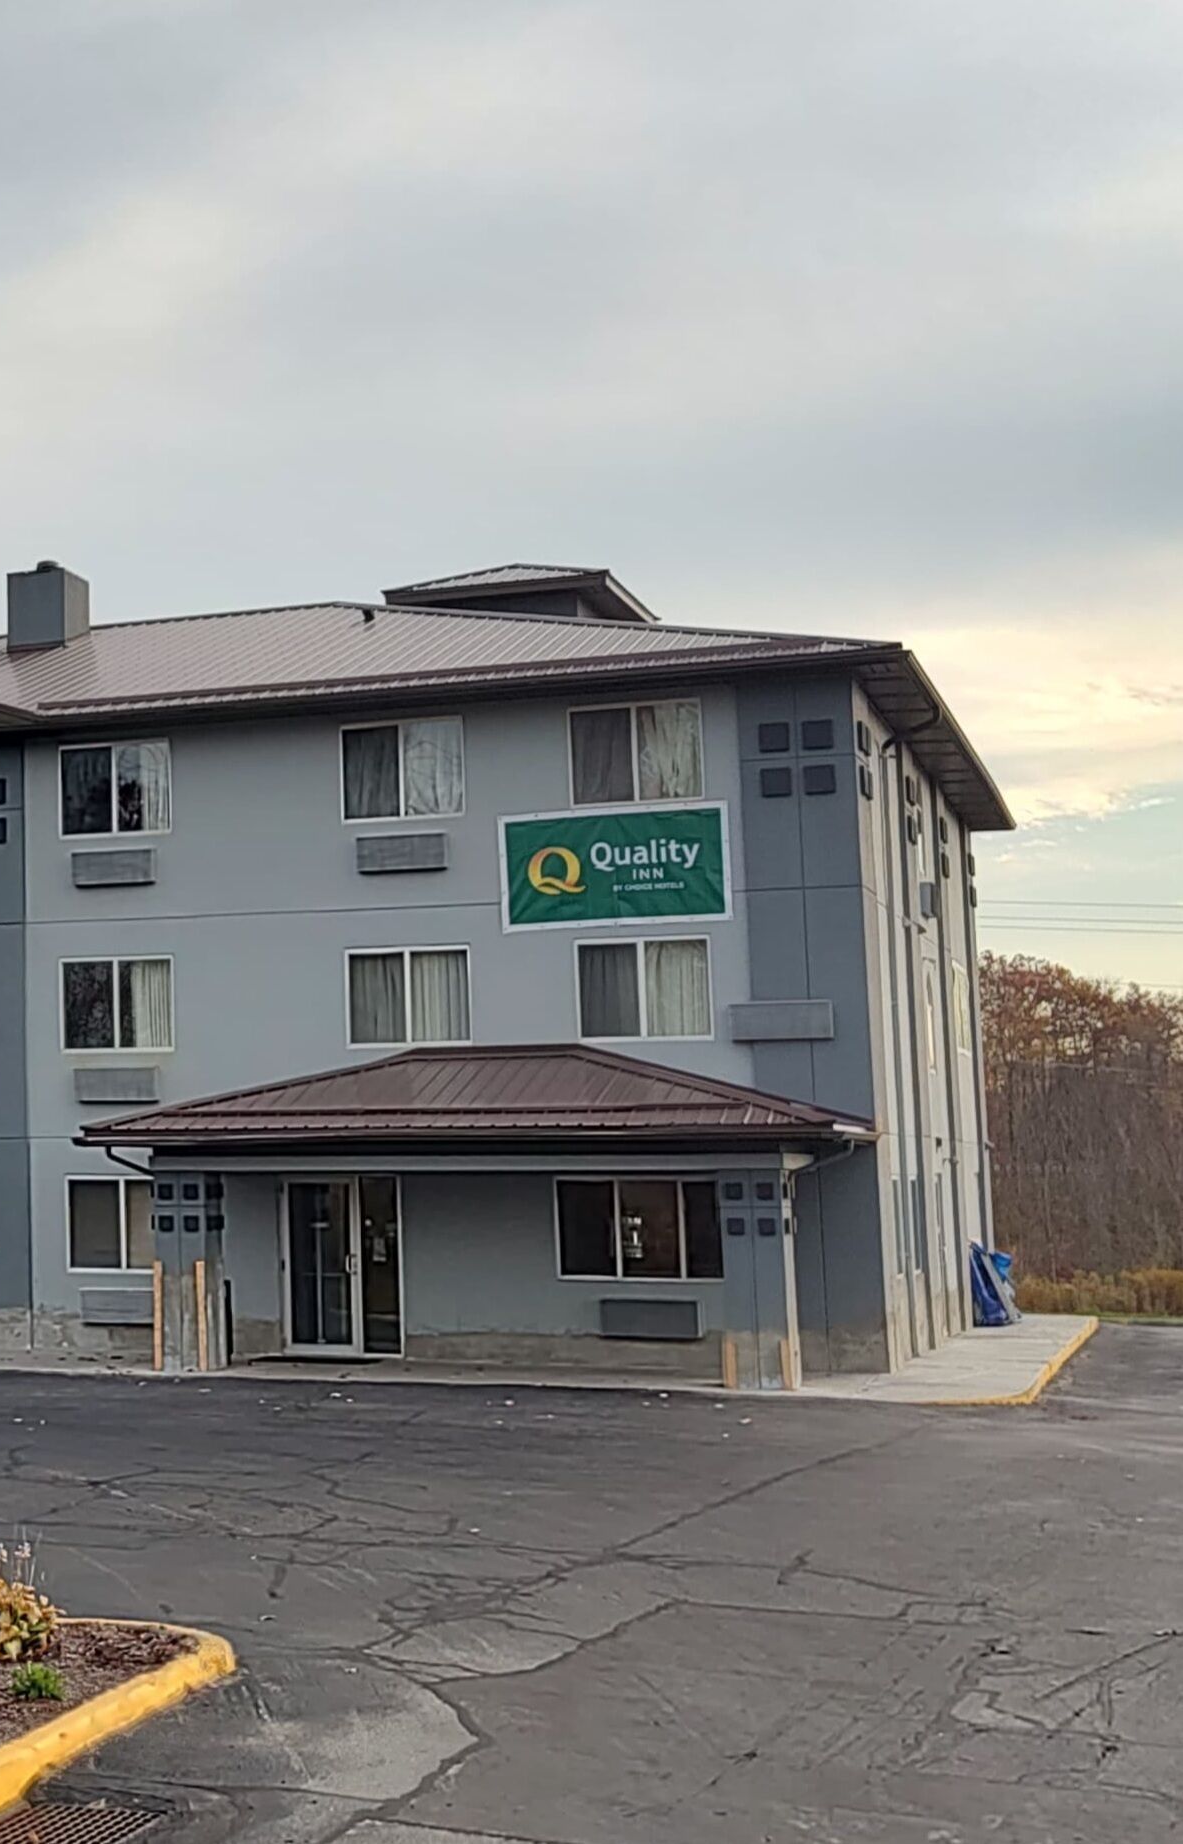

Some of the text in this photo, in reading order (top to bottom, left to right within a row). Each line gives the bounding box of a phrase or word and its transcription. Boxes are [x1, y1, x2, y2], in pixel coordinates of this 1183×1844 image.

[590, 838, 700, 872] Quality
[528, 846, 586, 895] Q
[632, 867, 664, 880] INN
[613, 881, 685, 892] BY CHOICE HOTELS
